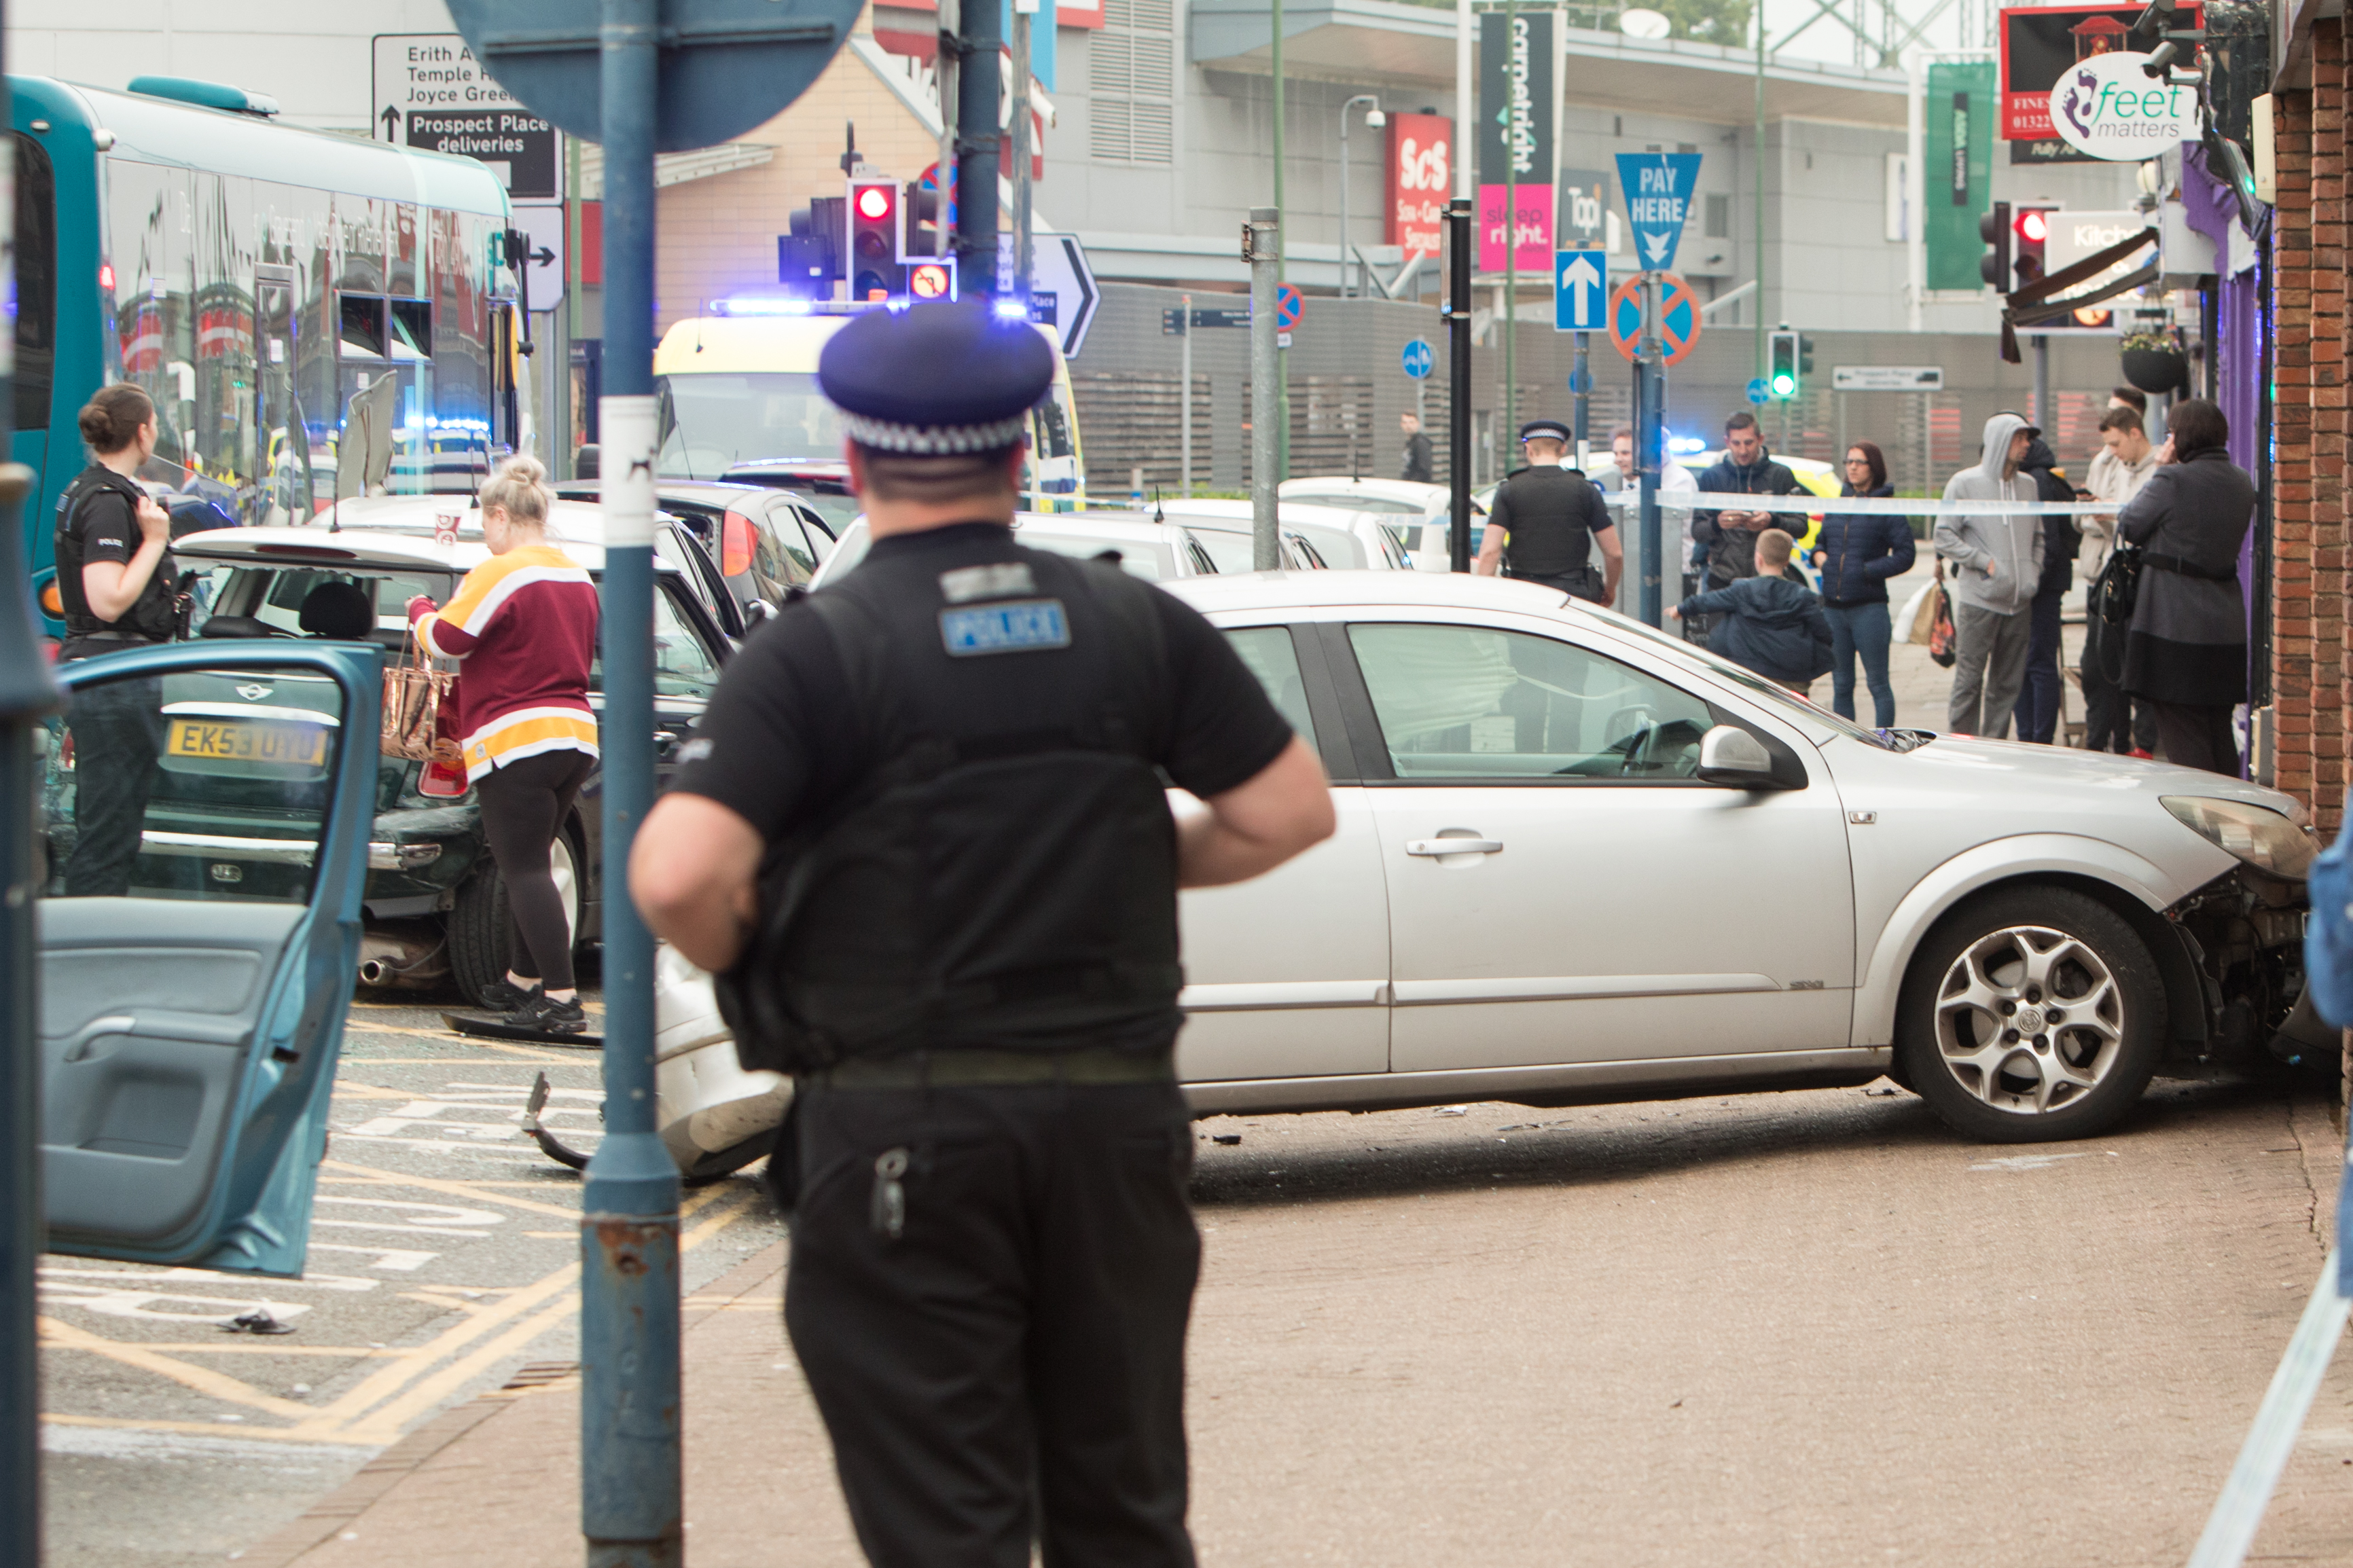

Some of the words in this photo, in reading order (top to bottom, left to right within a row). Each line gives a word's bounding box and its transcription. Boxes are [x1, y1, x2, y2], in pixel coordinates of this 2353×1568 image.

[408, 46, 452, 61] Erith
[460, 47, 473, 61] A
[408, 67, 472, 83] Temple
[408, 86, 458, 104] Joyce
[1501, 17, 1536, 174] carpetright
[2091, 81, 2183, 126] feet
[413, 115, 494, 135] Prospect
[500, 114, 550, 132] Place
[2013, 115, 2051, 129] 01322
[2098, 121, 2180, 137] matters
[437, 135, 525, 153] deliveries
[1400, 137, 1448, 192] ScS
[1640, 167, 1677, 192] PAY
[1632, 197, 1683, 222] HERE
[2074, 224, 2140, 247] Kitch
[181, 725, 253, 756] EK53
